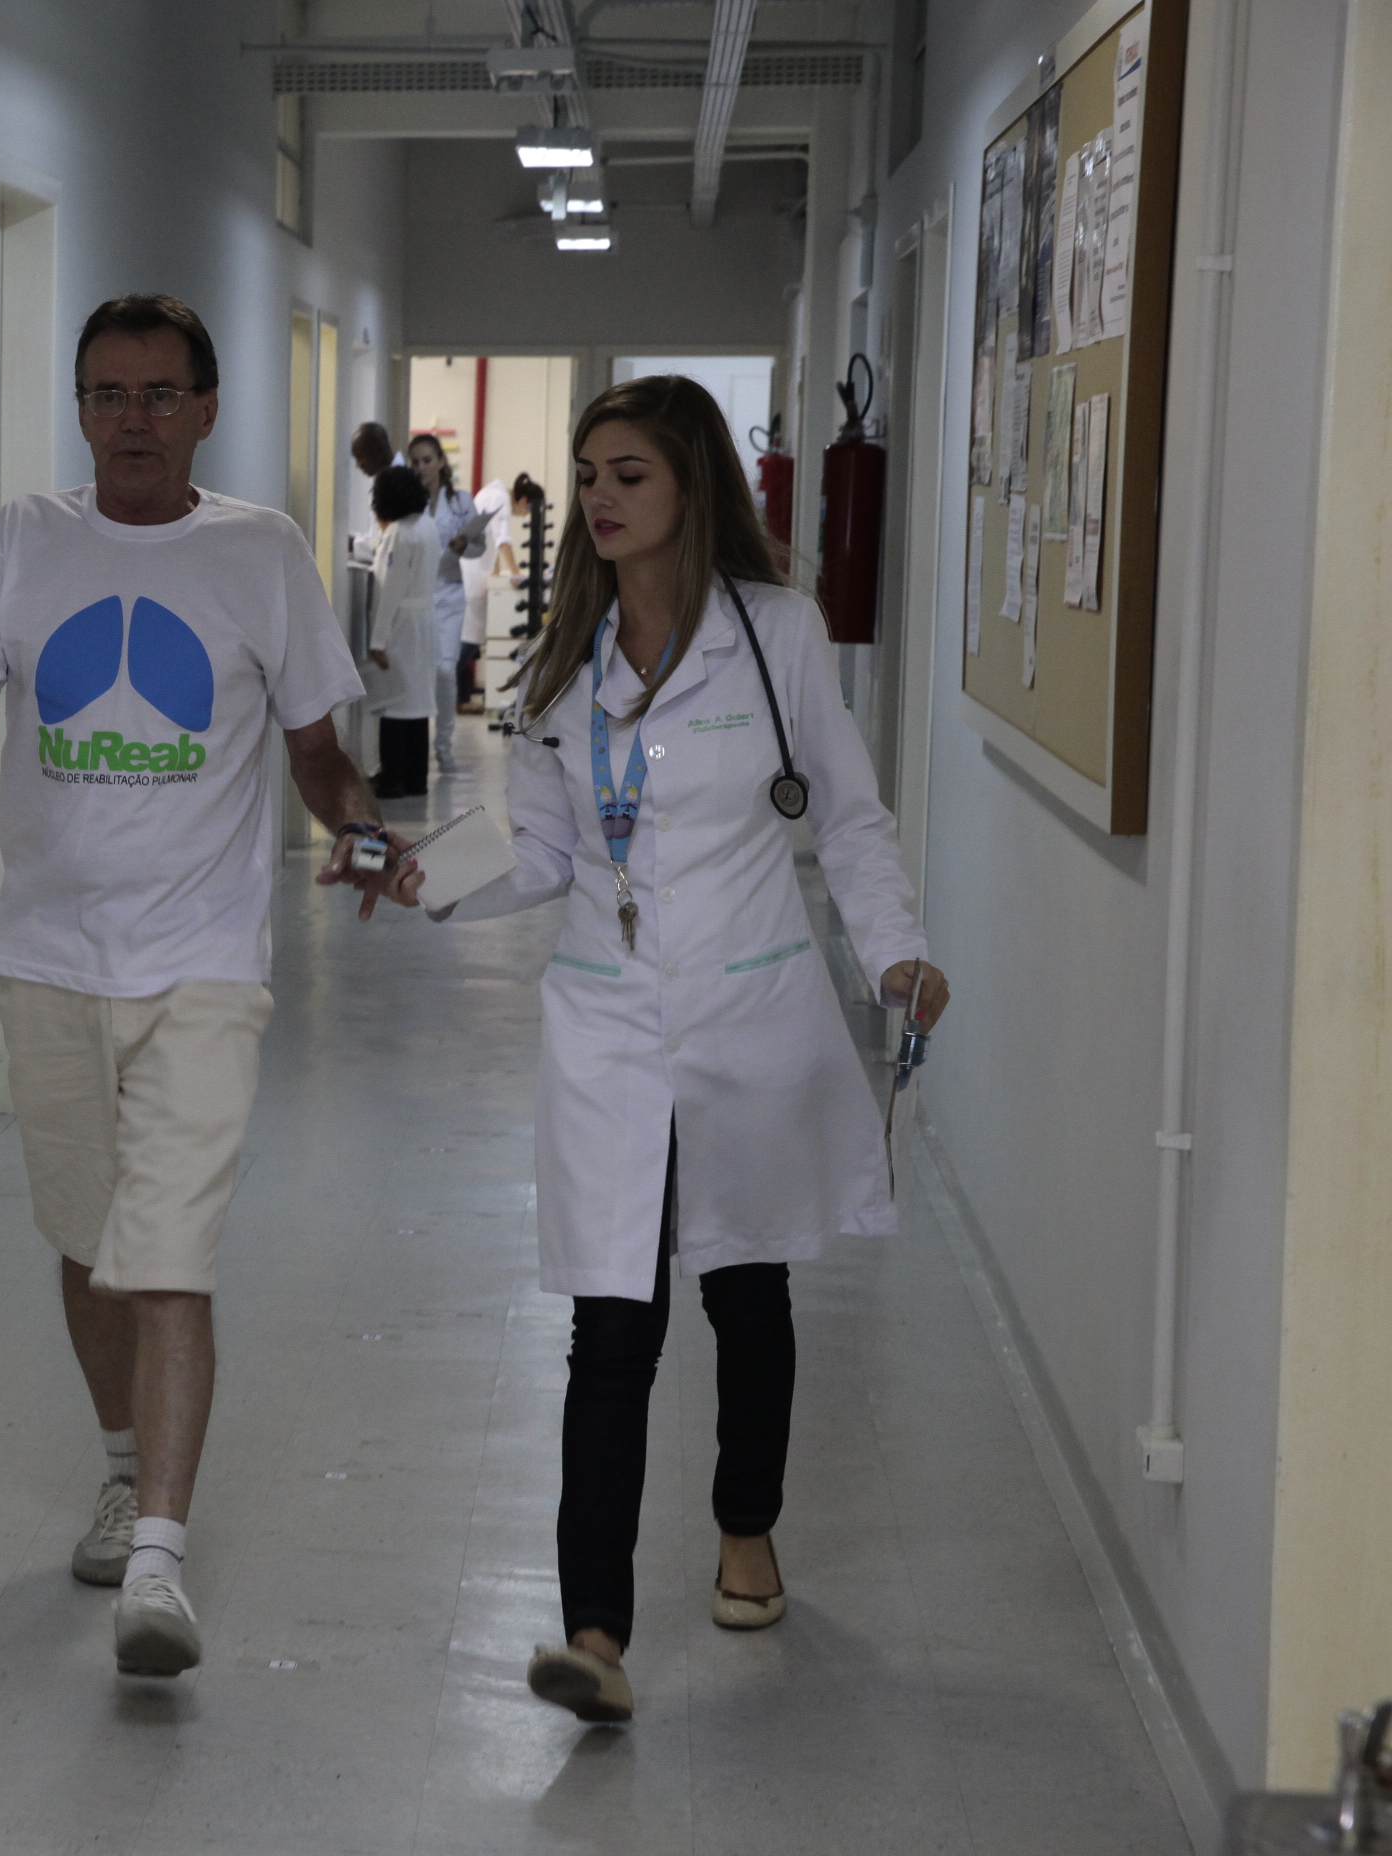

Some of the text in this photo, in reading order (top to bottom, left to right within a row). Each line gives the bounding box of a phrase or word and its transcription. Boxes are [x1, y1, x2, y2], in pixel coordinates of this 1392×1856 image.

[38, 725, 206, 773] NuReab
[67, 773, 80, 783] DE
[83, 773, 149, 788] REABILITAÇÃO
[152, 773, 197, 786] PULMONAR
